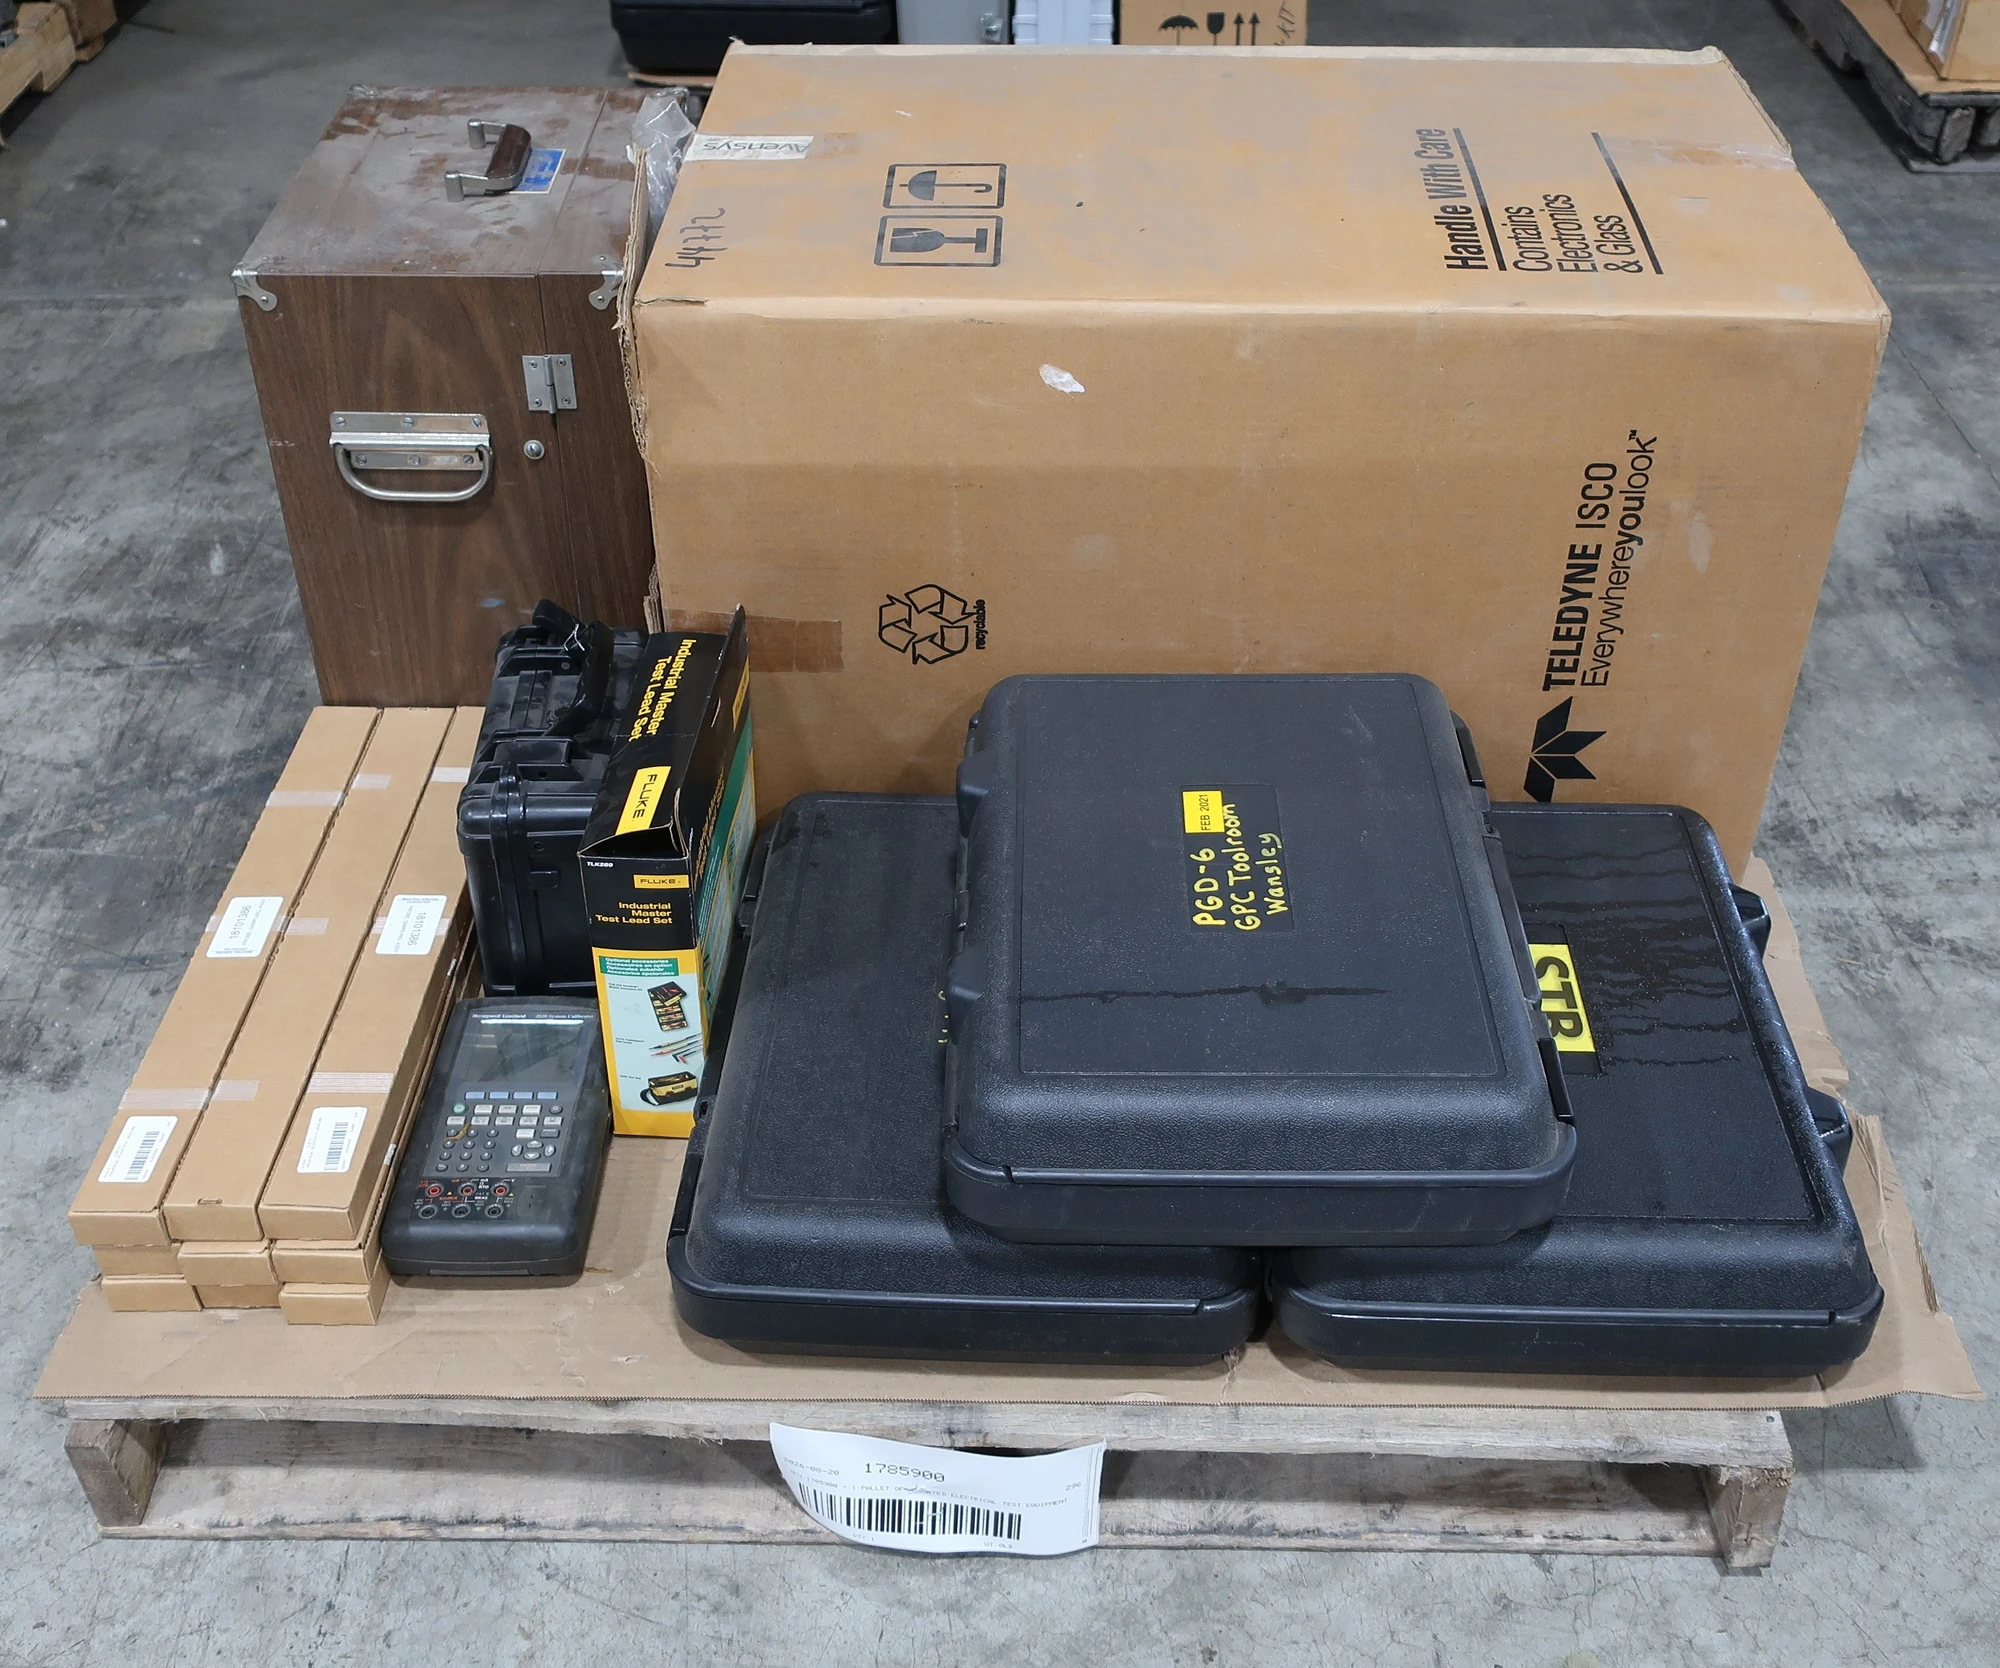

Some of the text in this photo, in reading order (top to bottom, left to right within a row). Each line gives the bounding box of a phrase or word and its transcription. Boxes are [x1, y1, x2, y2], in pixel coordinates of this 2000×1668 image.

[703, 139, 811, 153] Avensys
[1413, 127, 1489, 270] Handle With Care
[1502, 205, 1553, 272] Contains
[1538, 193, 1599, 273] Electronics
[1593, 214, 1644, 274] & Glass
[1542, 463, 1618, 691] TELEDYNE ISCO
[972, 599, 989, 650] recyclable
[628, 655, 673, 742] Test Lead Set
[646, 638, 698, 736] Industrial Master
[632, 773, 657, 819] FLUKE
[1198, 794, 1211, 831] FEB 2021
[1190, 847, 1227, 926] PGD-6
[1220, 803, 1262, 930] GPC Toolroom
[1254, 832, 1290, 916] Wansley
[595, 914, 620, 923] Test
[618, 902, 671, 910] Industrial
[631, 909, 672, 917] Master
[864, 1462, 945, 1483] 1785900
[1065, 1482, 1082, 1491] 296
[950, 1493, 997, 1505] ELECTRICAL
[1025, 1498, 1068, 1508] EQUIPMENT
